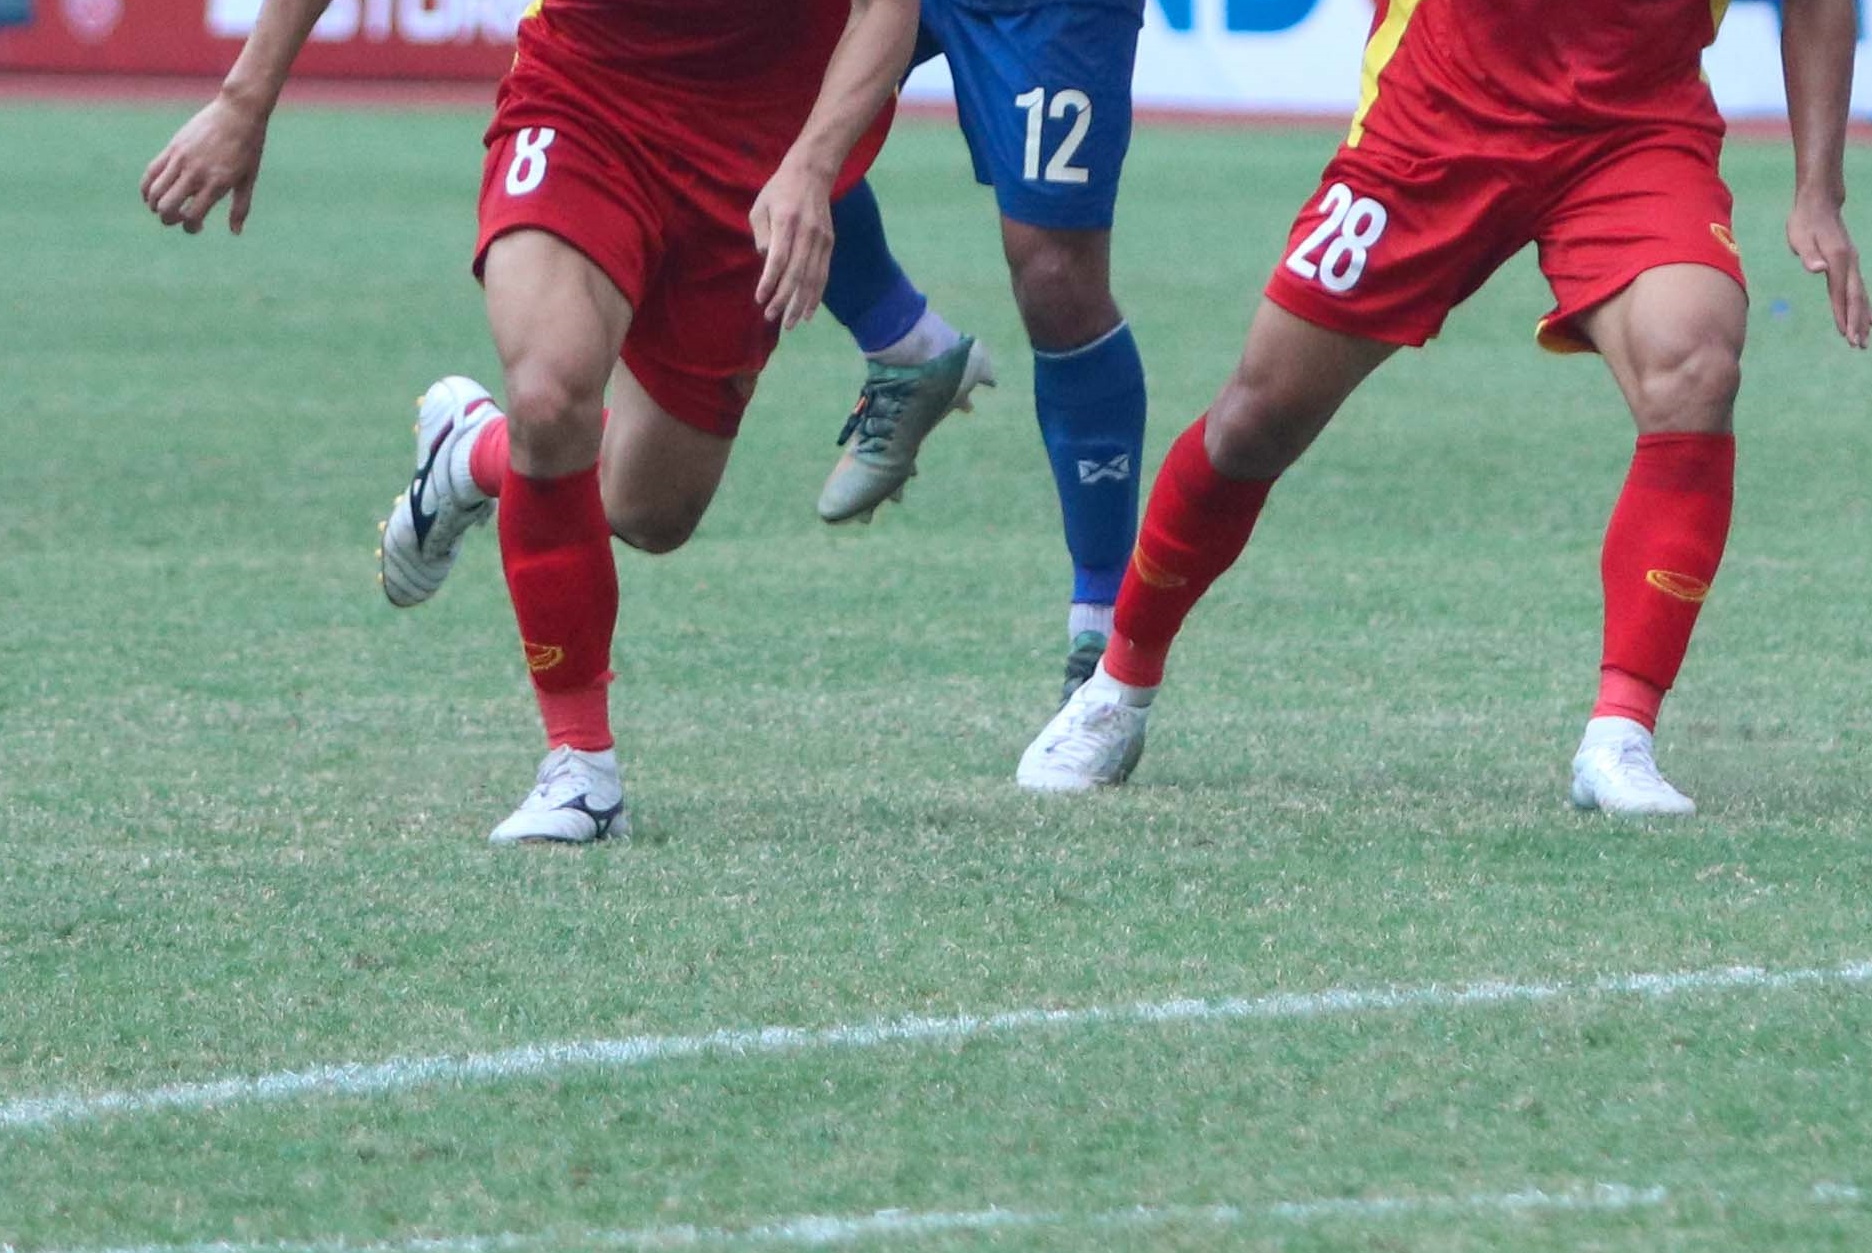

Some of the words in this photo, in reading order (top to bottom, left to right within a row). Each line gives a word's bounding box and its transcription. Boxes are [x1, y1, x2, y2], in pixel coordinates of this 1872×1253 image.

[504, 127, 557, 197] 8
[1014, 86, 1092, 184] 12
[1285, 182, 1389, 294] 28
